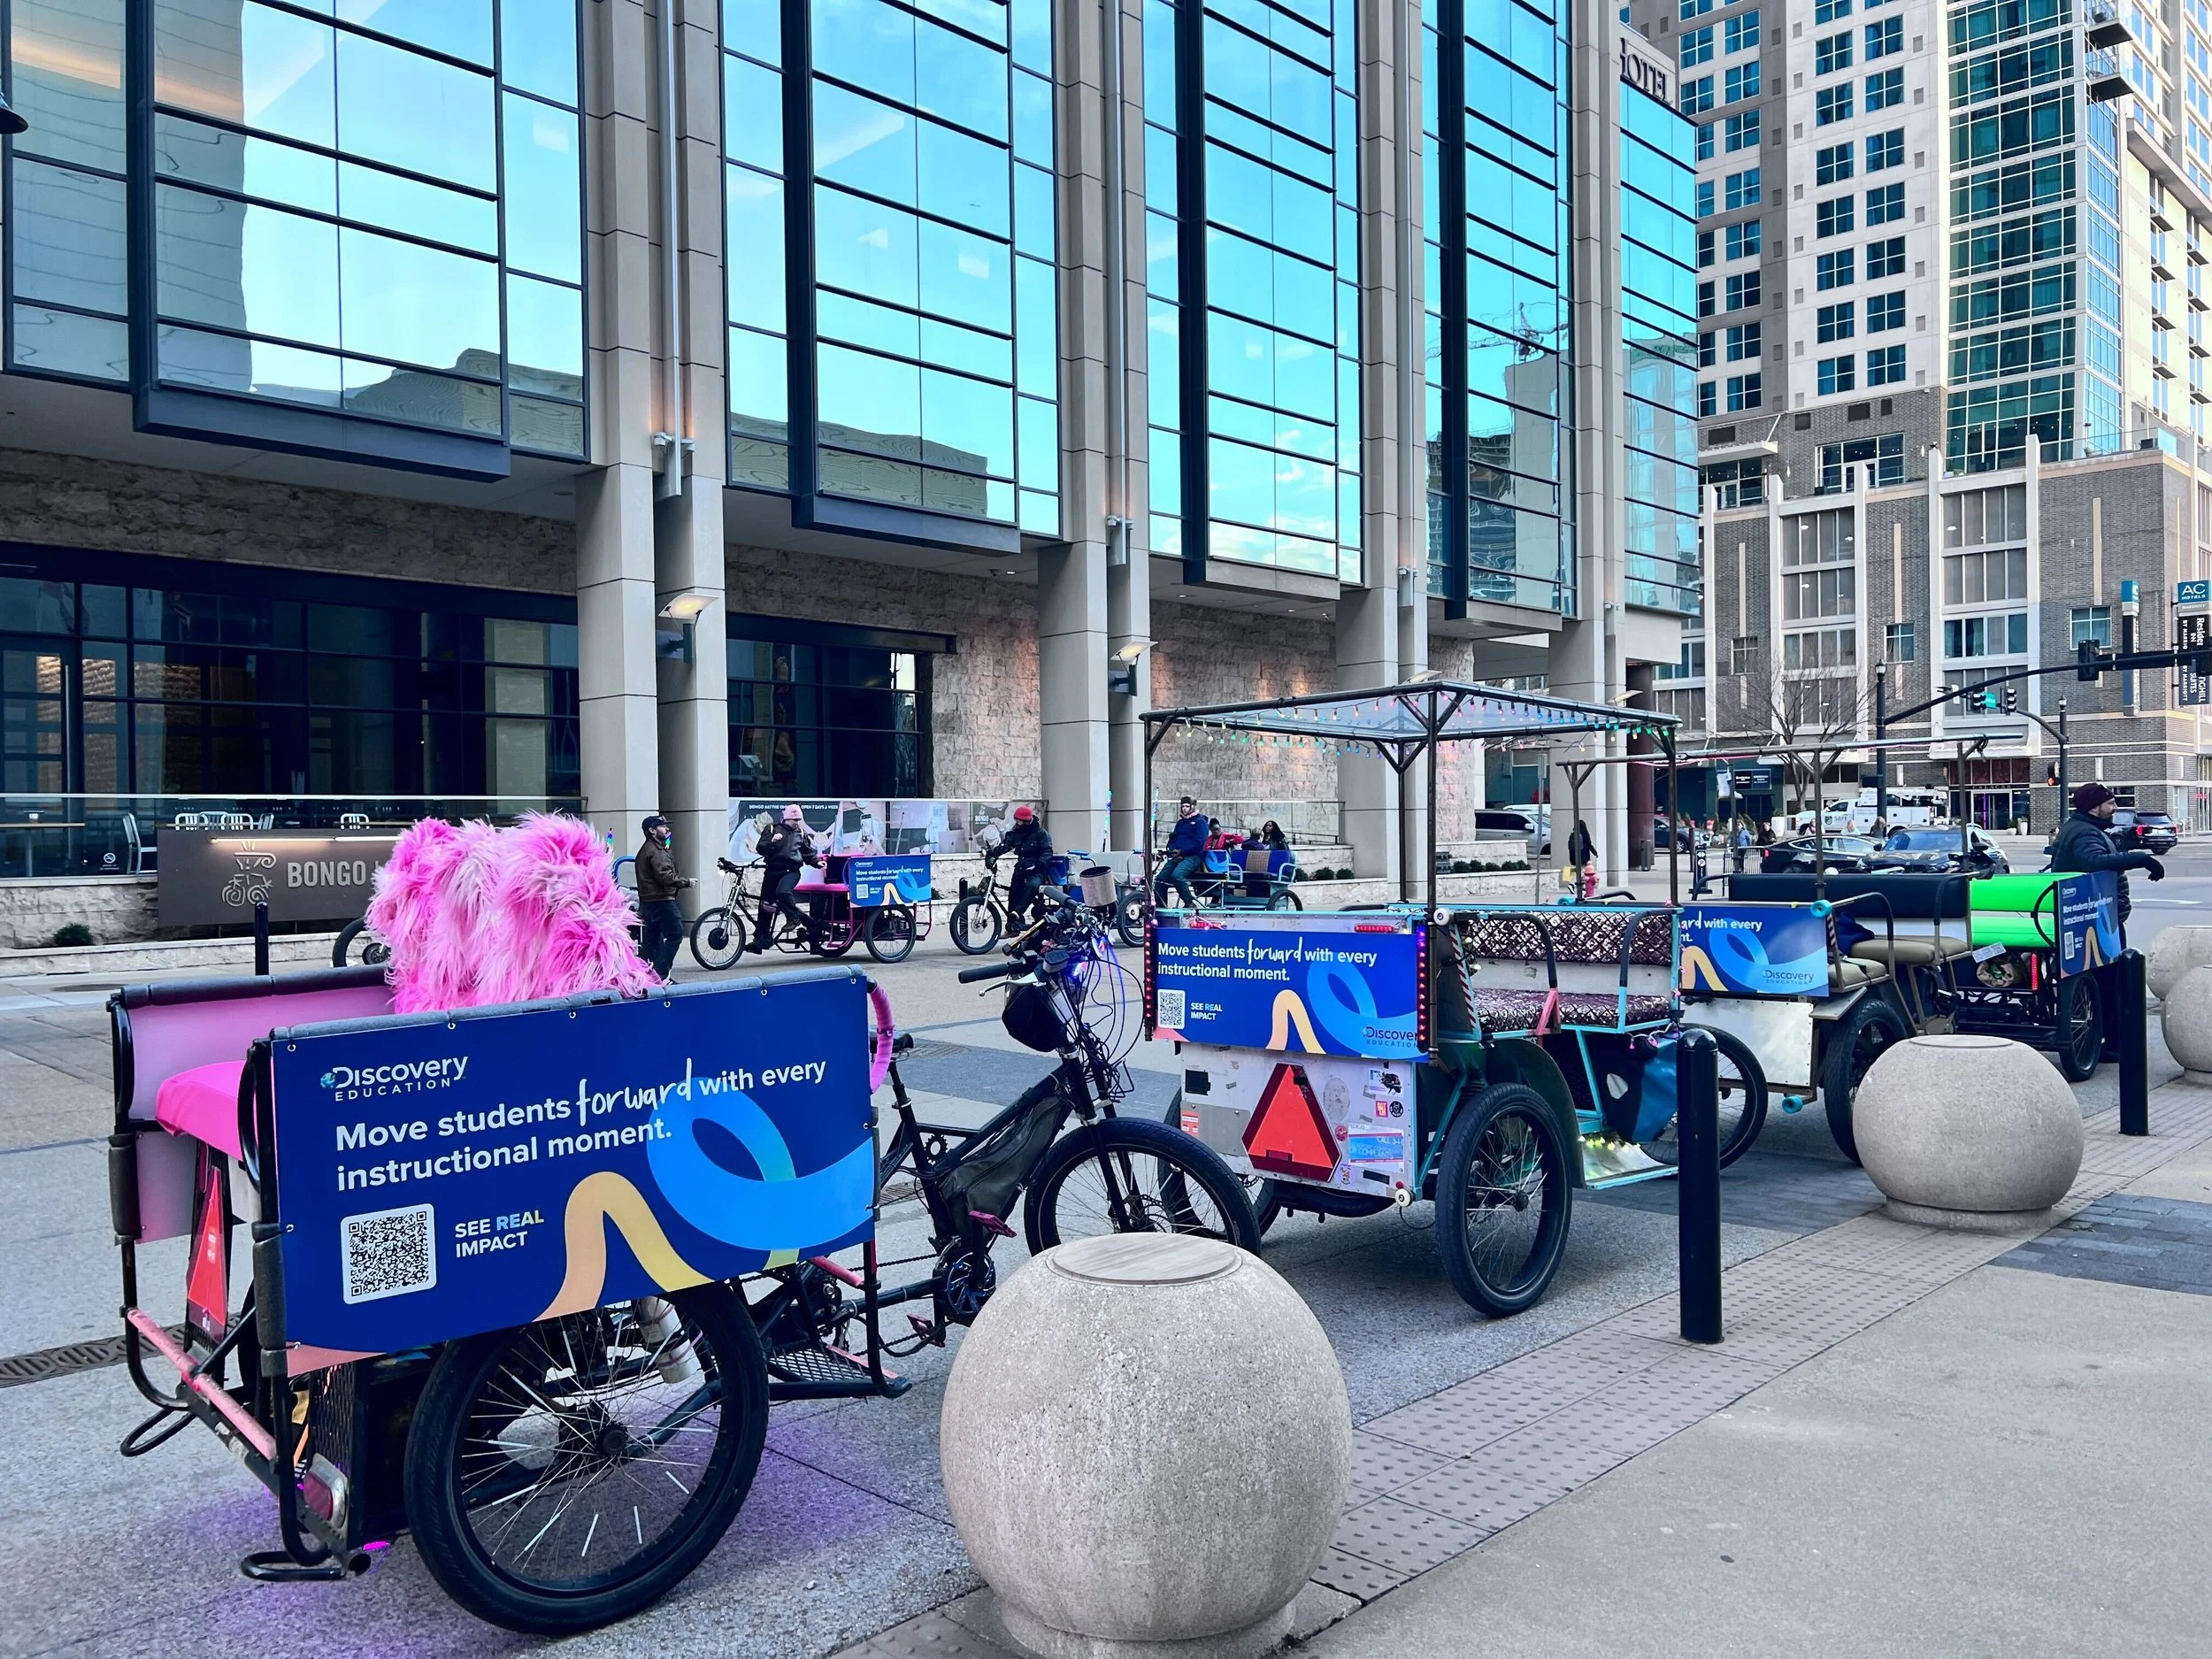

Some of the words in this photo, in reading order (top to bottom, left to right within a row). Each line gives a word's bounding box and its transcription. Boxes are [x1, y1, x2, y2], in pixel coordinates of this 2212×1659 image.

[2182, 583, 2206, 595] AC
[288, 861, 365, 887] BONGO
[1703, 918, 1728, 929] with
[1731, 921, 1763, 932] every
[1158, 943, 1189, 956] Move
[1192, 945, 1245, 959] students
[1247, 936, 1303, 964] forward
[1305, 948, 1333, 963] with
[1338, 952, 1377, 967] every
[1158, 964, 1231, 979] instructional
[1233, 966, 1290, 981] moment.
[1765, 970, 1814, 983] Discovery
[1191, 1002, 1203, 1010] SEE
[1205, 1002, 1223, 1011] REAL
[1191, 1011, 1216, 1020] IMPACT
[1366, 1026, 1417, 1041] Discover
[332, 1056, 469, 1089] Discovery
[335, 1078, 450, 1102] EDUCATION
[336, 1123, 428, 1151] Move
[438, 1098, 571, 1136] students
[576, 1057, 692, 1126] forward
[699, 1068, 754, 1095] with
[761, 1061, 826, 1086] every
[337, 1137, 537, 1192] instructional
[548, 1118, 672, 1157] moment.
[455, 1218, 491, 1239] SEE
[496, 1210, 544, 1231] REAL
[456, 1231, 528, 1258] IMPACT
